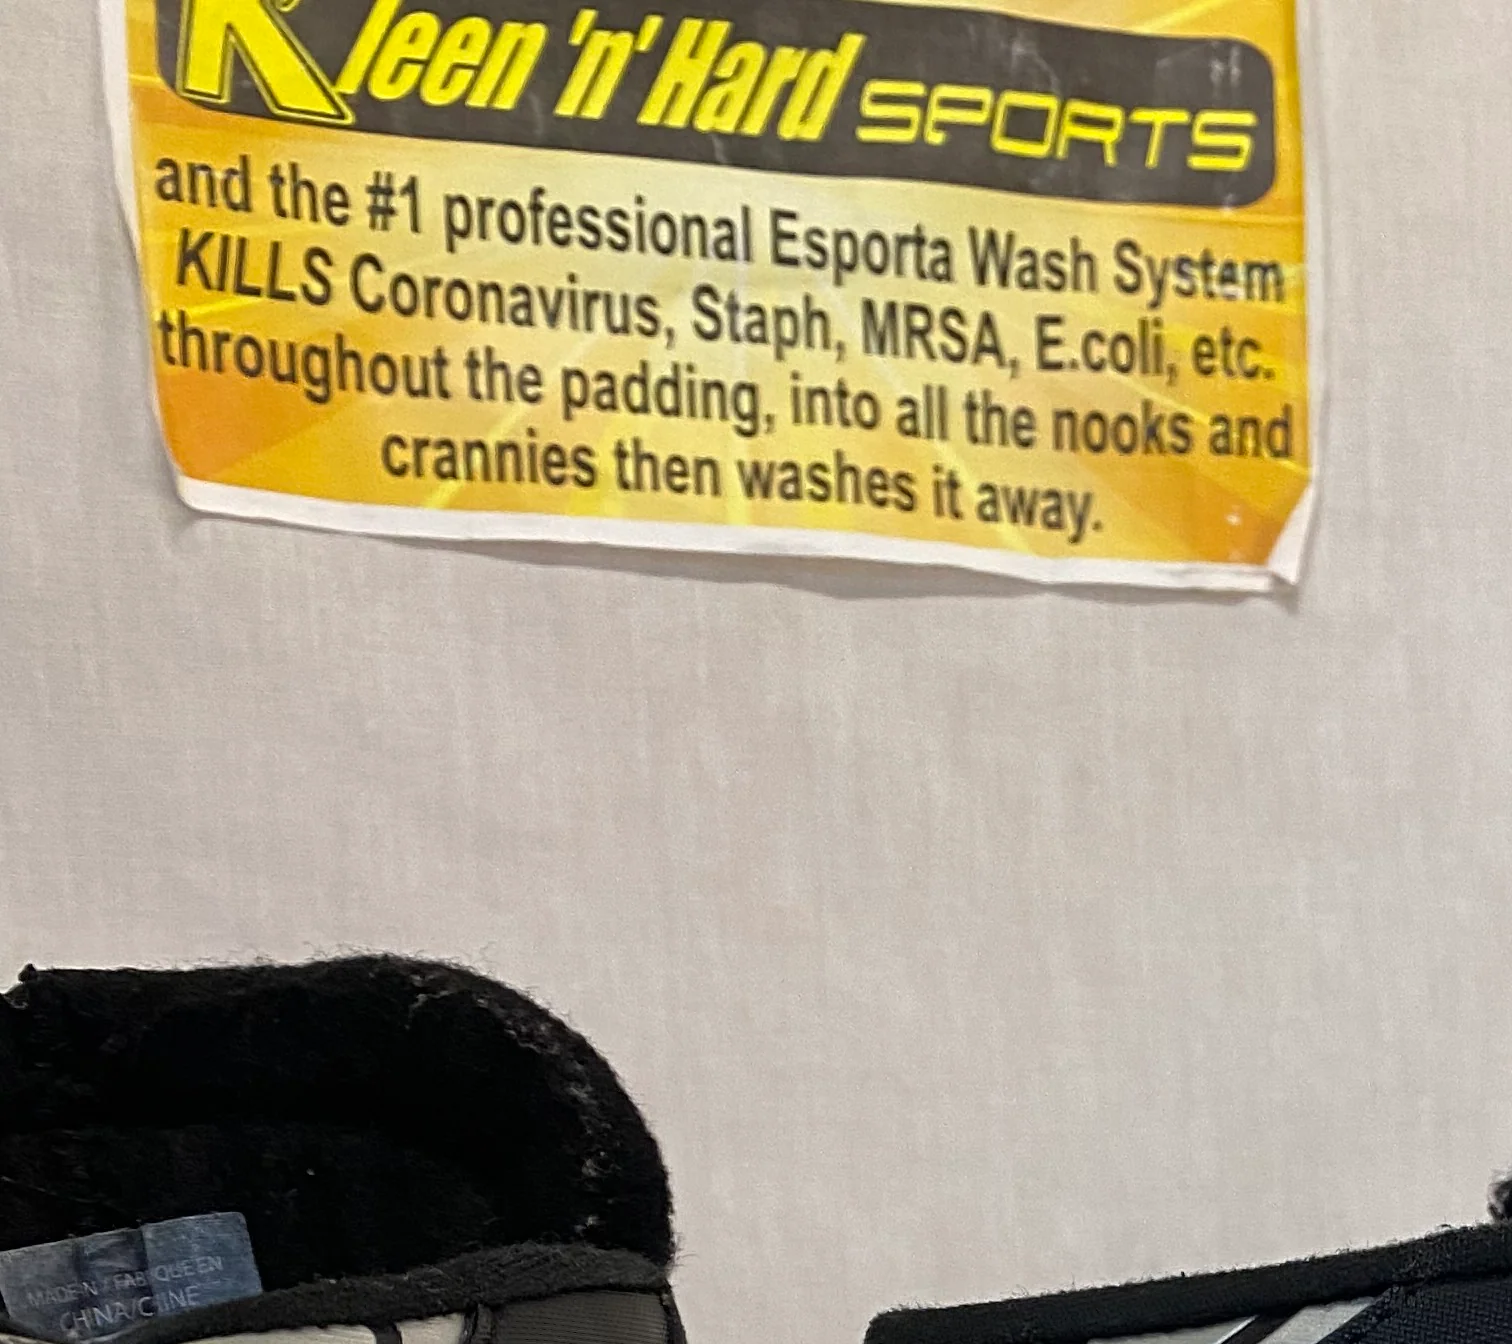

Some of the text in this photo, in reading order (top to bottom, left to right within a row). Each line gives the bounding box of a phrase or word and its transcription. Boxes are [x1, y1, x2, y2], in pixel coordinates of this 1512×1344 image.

[637, 17, 867, 142] Hard
[856, 79, 1258, 171] SPORTS
[155, 155, 1285, 309] and the #1 professional Esporta Wash System
[176, 228, 1275, 385] KILLS Coronavirus, Staph, MRSA, E.coli, etc.
[158, 310, 1294, 459] throughout the padding, into all the nooks and
[381, 428, 1103, 545] crannies then washes it away.
[112, 1259, 196, 1290] FABQUE
